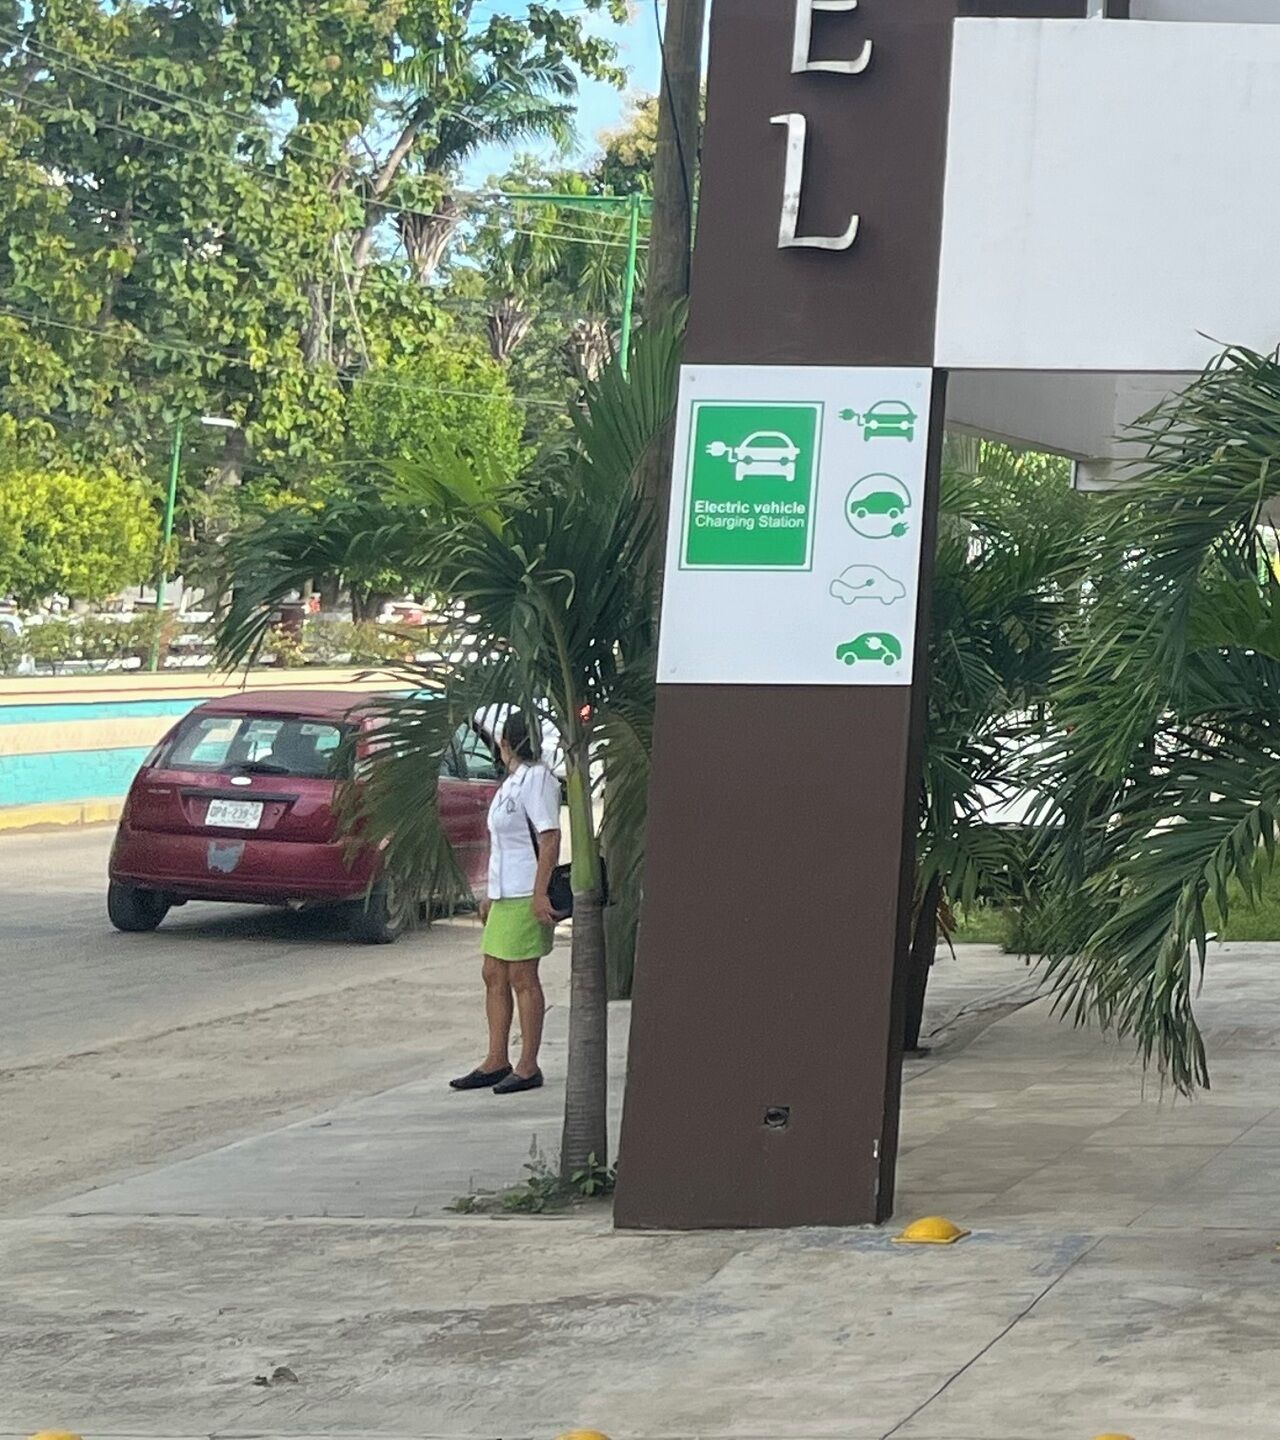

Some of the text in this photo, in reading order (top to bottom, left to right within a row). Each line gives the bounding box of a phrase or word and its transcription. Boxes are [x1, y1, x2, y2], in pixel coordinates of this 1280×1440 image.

[694, 500, 806, 515] Electric vehicle
[695, 514, 805, 530] Charging Station
